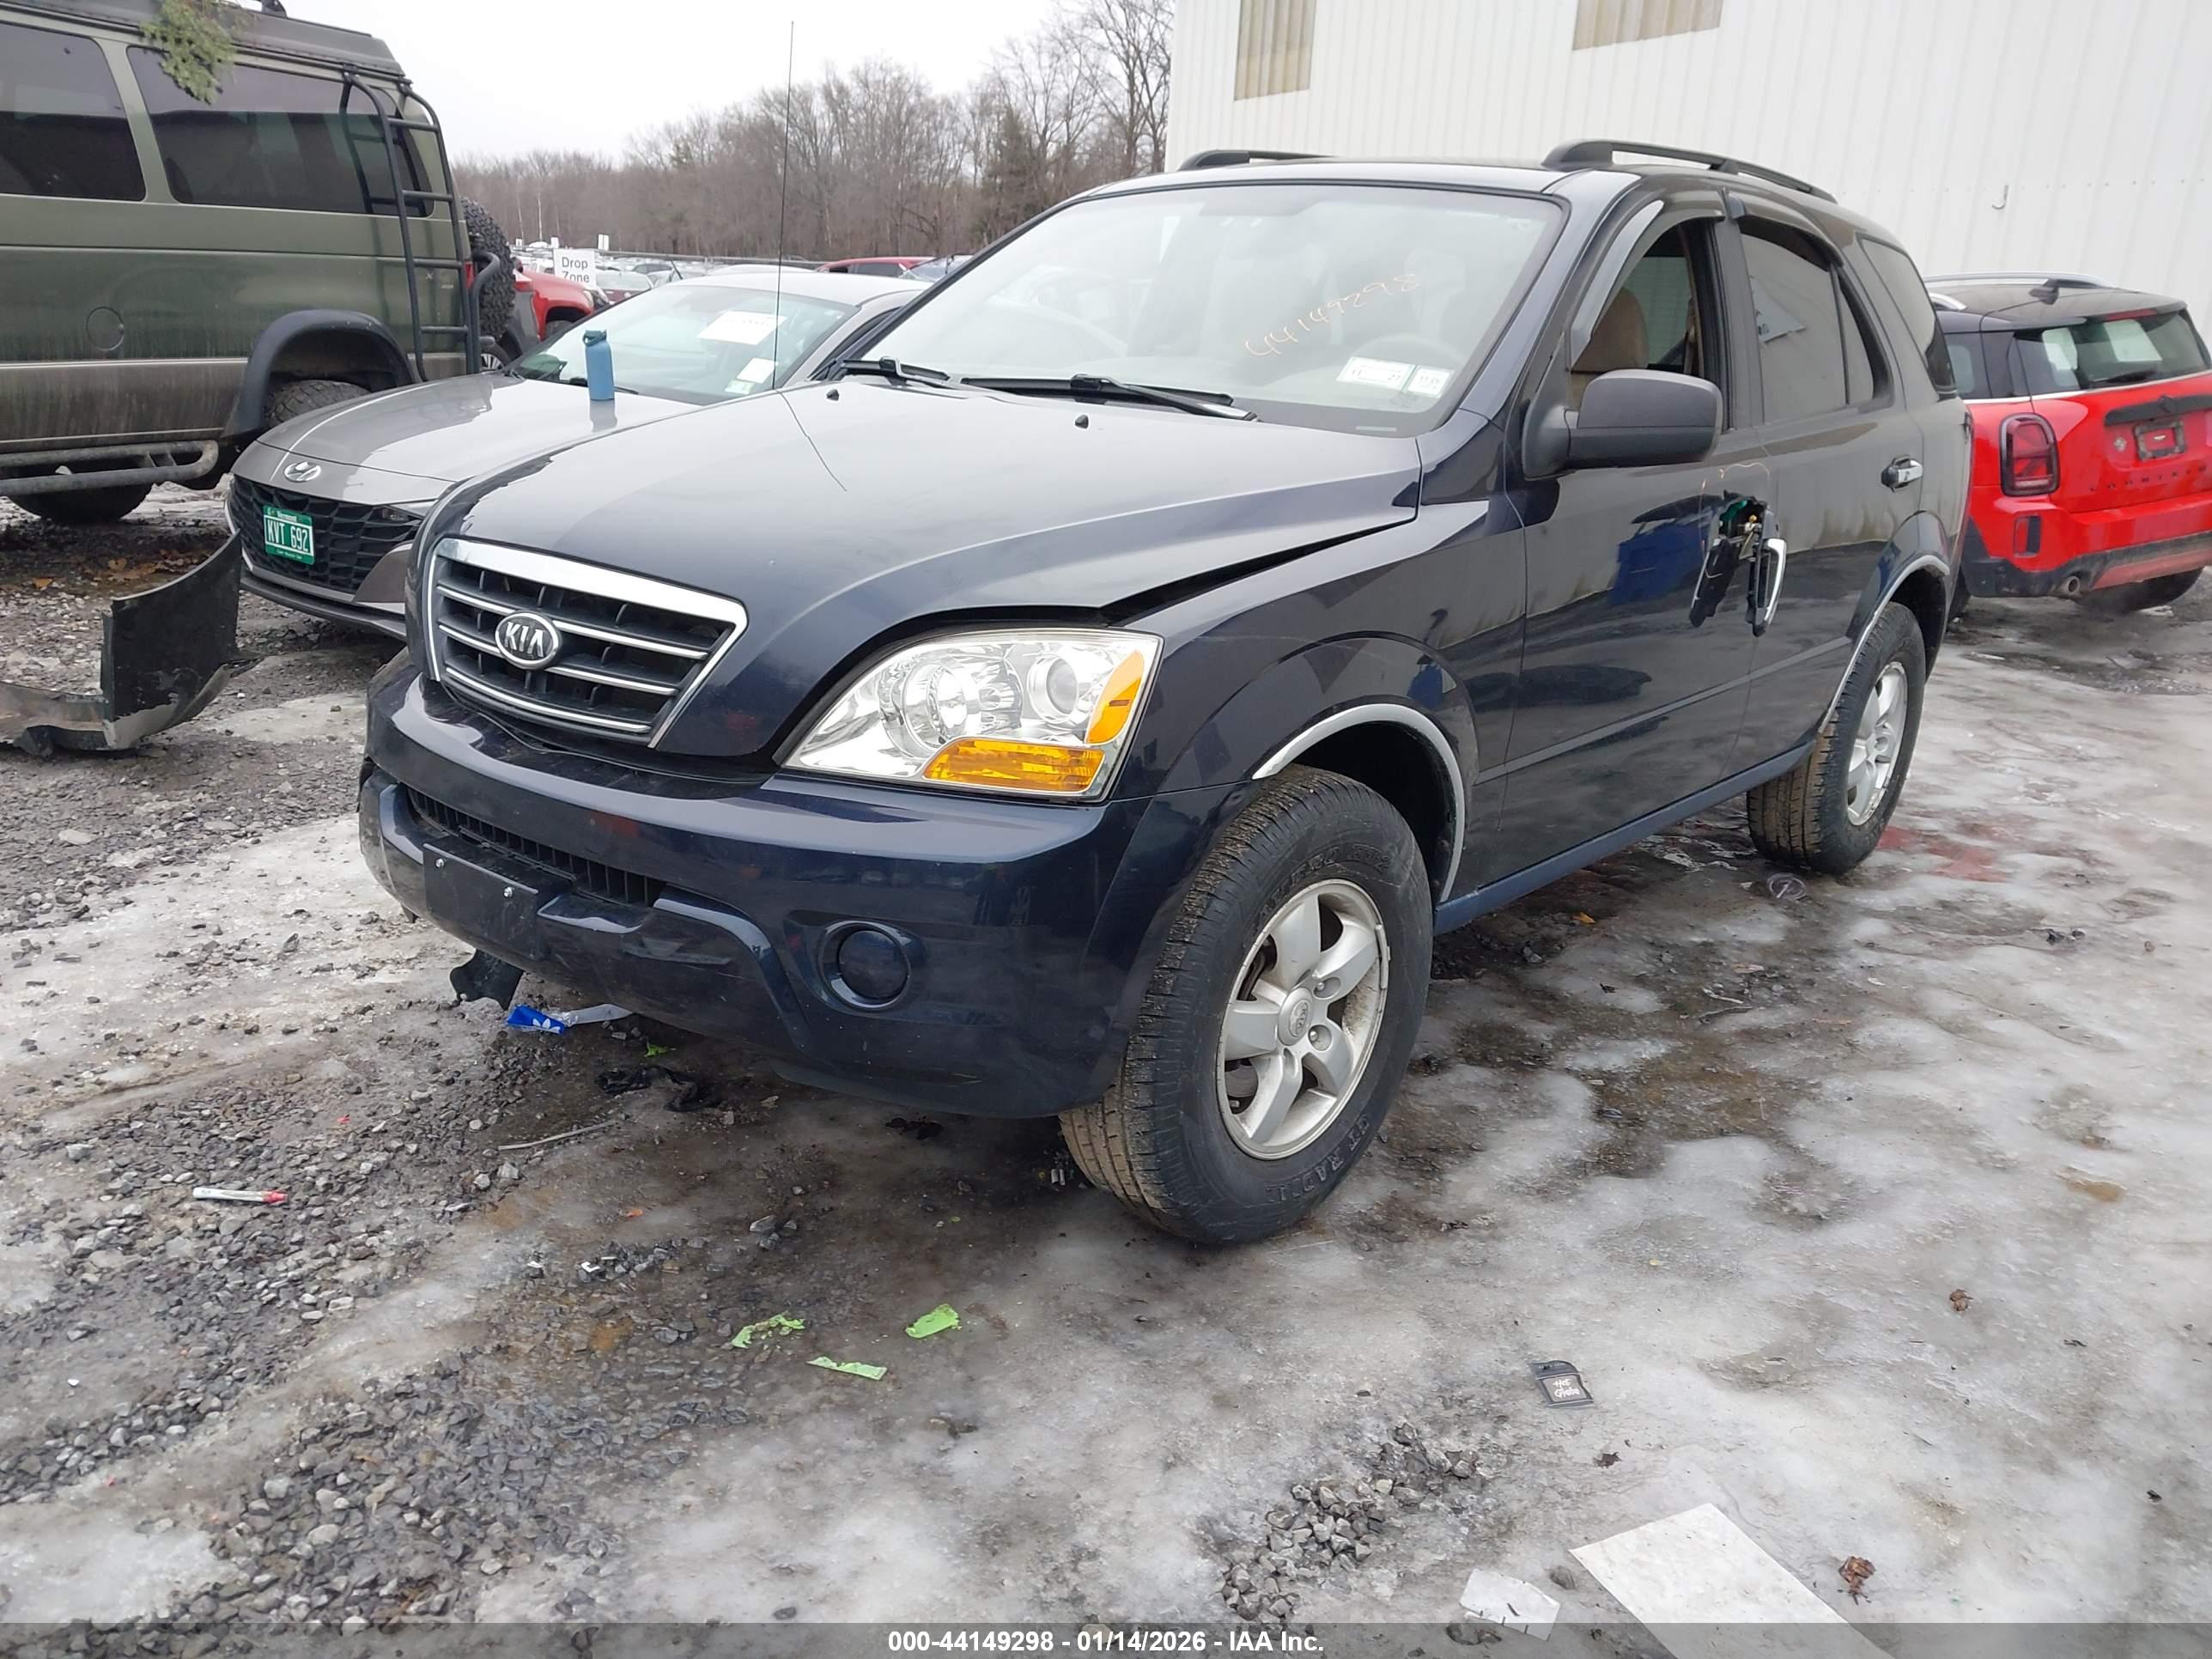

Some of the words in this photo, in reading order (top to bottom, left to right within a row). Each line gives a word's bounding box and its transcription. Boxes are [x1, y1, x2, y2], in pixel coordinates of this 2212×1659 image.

[562, 257, 588, 270] Drop
[1245, 274, 1419, 356] 44149298
[267, 519, 285, 545] KVT
[290, 525, 309, 552] 692
[504, 621, 544, 658] KIA
